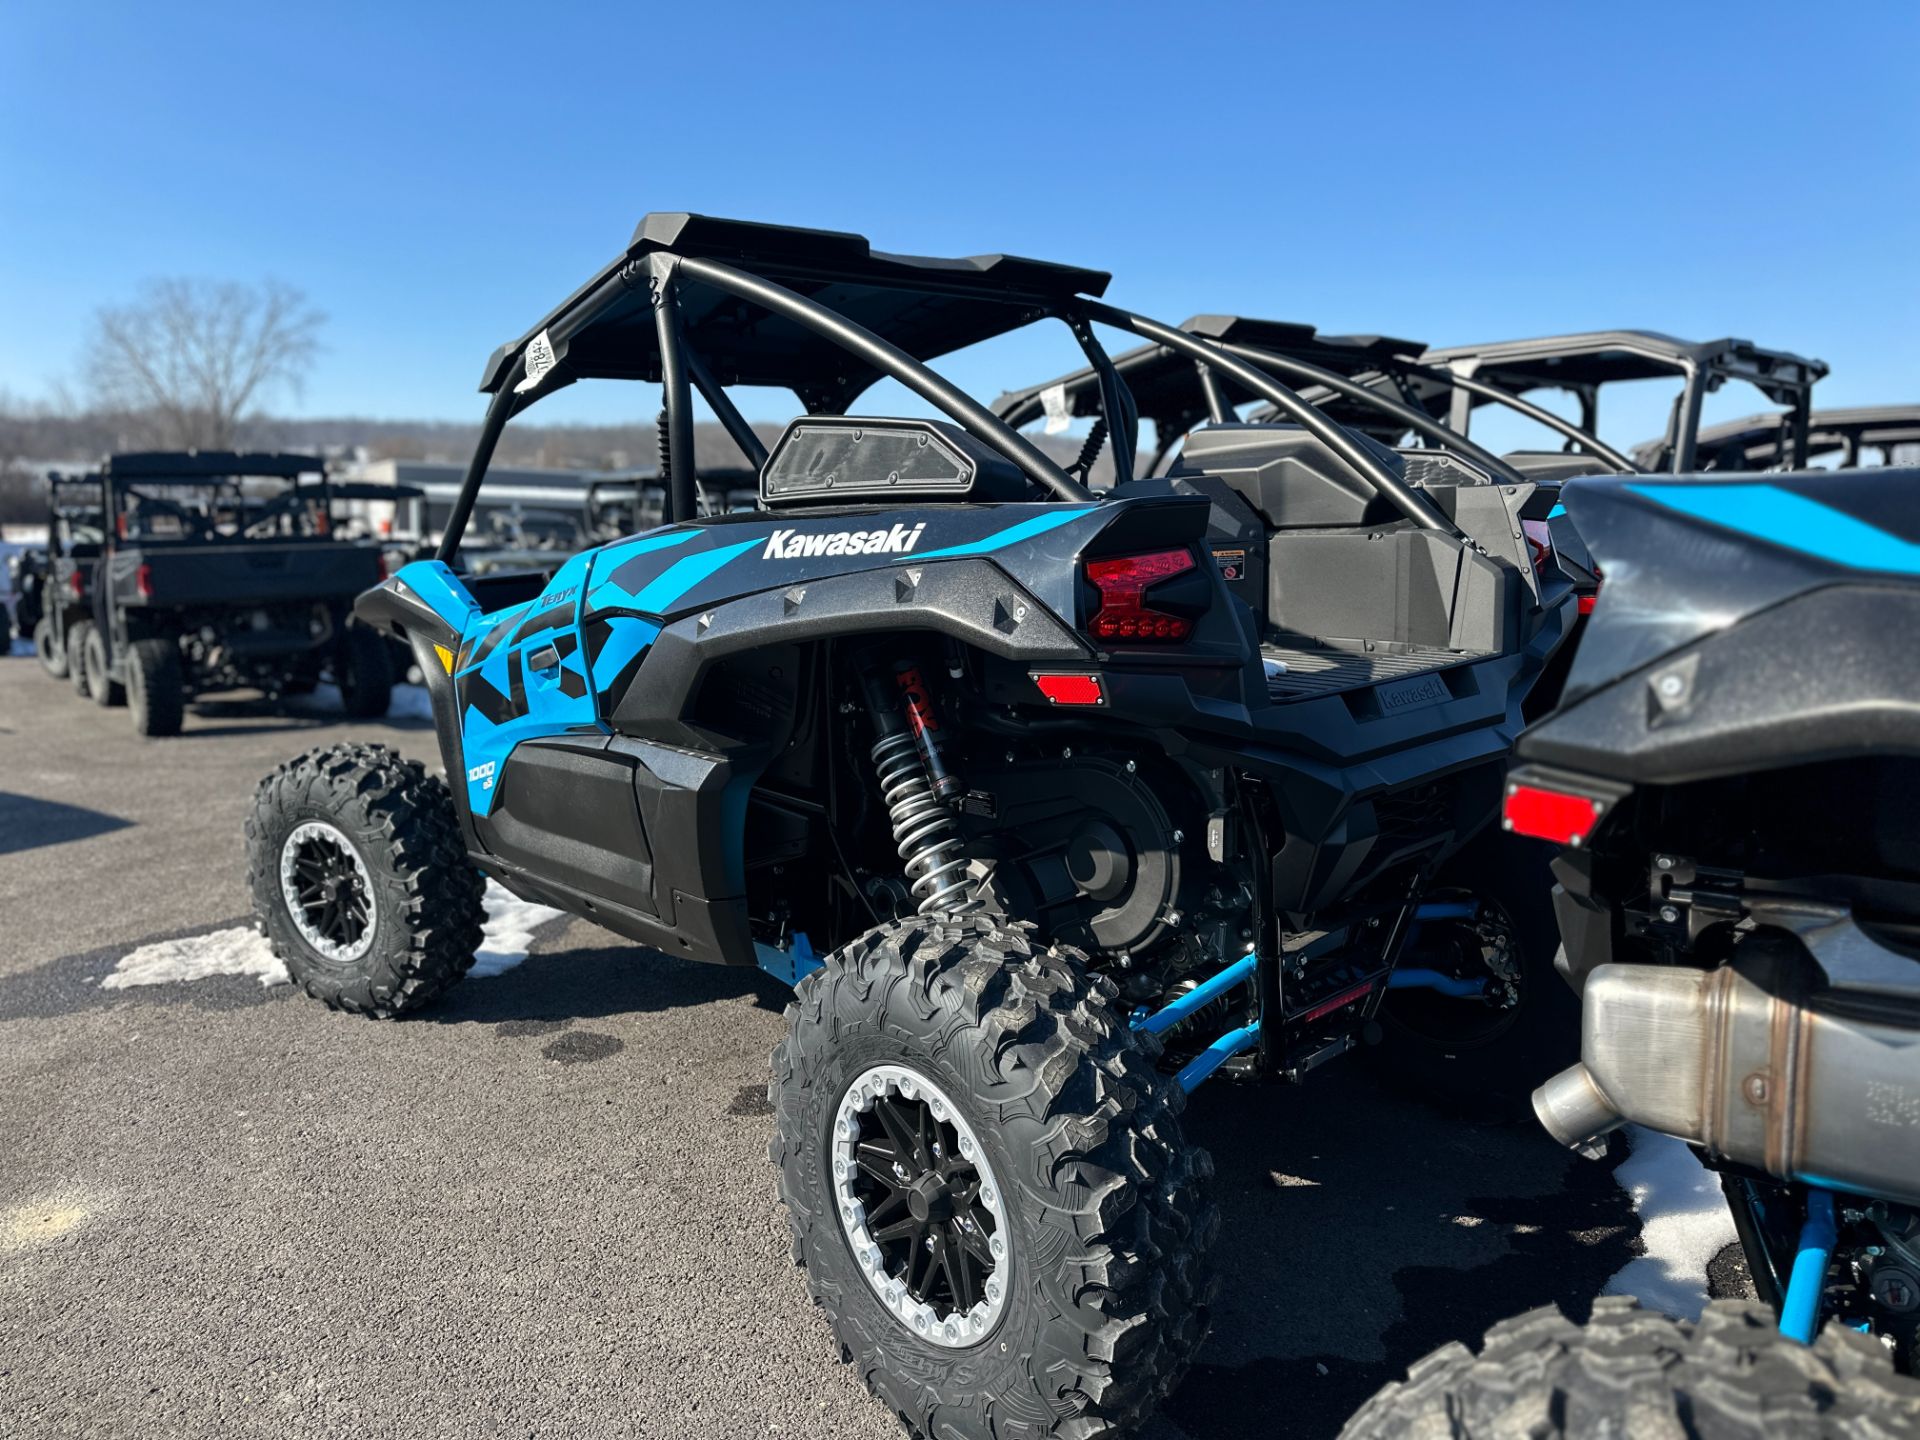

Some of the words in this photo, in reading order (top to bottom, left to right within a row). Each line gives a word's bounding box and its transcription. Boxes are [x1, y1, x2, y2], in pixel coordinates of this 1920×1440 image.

[763, 522, 926, 560] Kawasaki
[1380, 679, 1446, 709] Kawasaki
[468, 760, 496, 782] 1000
